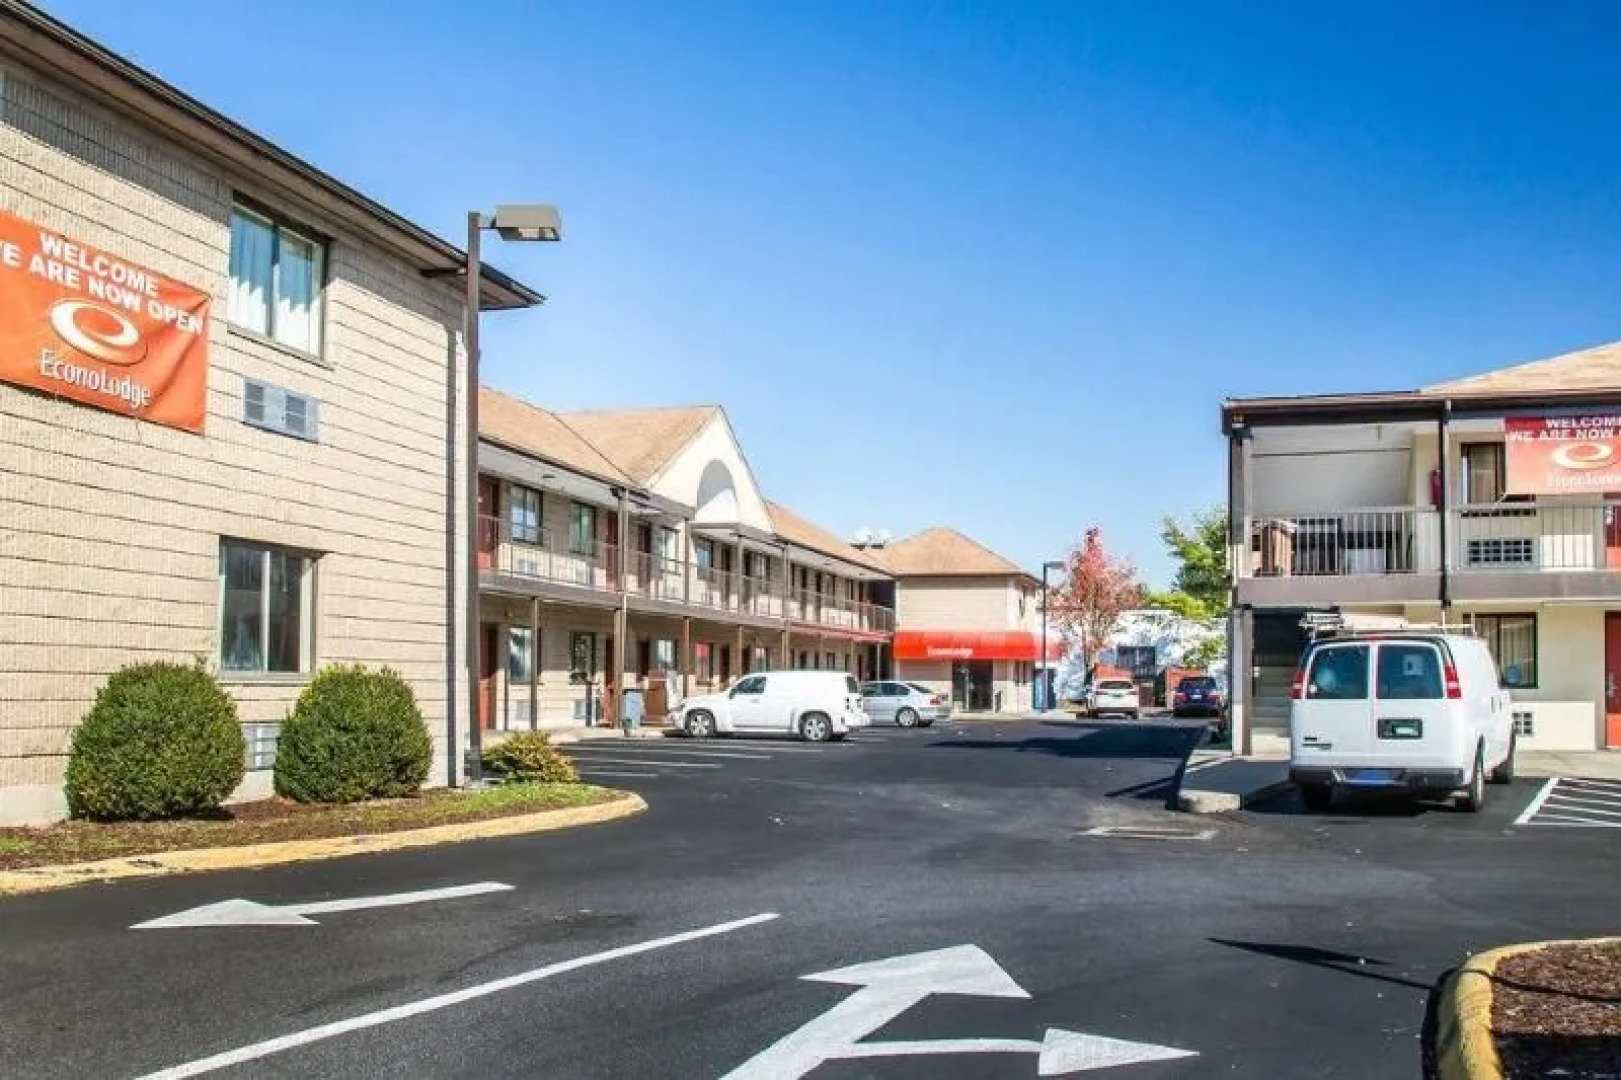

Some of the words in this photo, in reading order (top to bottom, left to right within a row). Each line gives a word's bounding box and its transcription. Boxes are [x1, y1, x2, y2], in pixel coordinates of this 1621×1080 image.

[40, 232, 159, 297] WELCOME
[0, 241, 21, 268] E
[29, 254, 81, 290] ARE
[88, 276, 141, 311] NOW
[148, 301, 203, 335] OPEN
[1540, 429, 1570, 440] ARE
[1575, 428, 1613, 440] NOW
[1545, 416, 1621, 429] WELCOM
